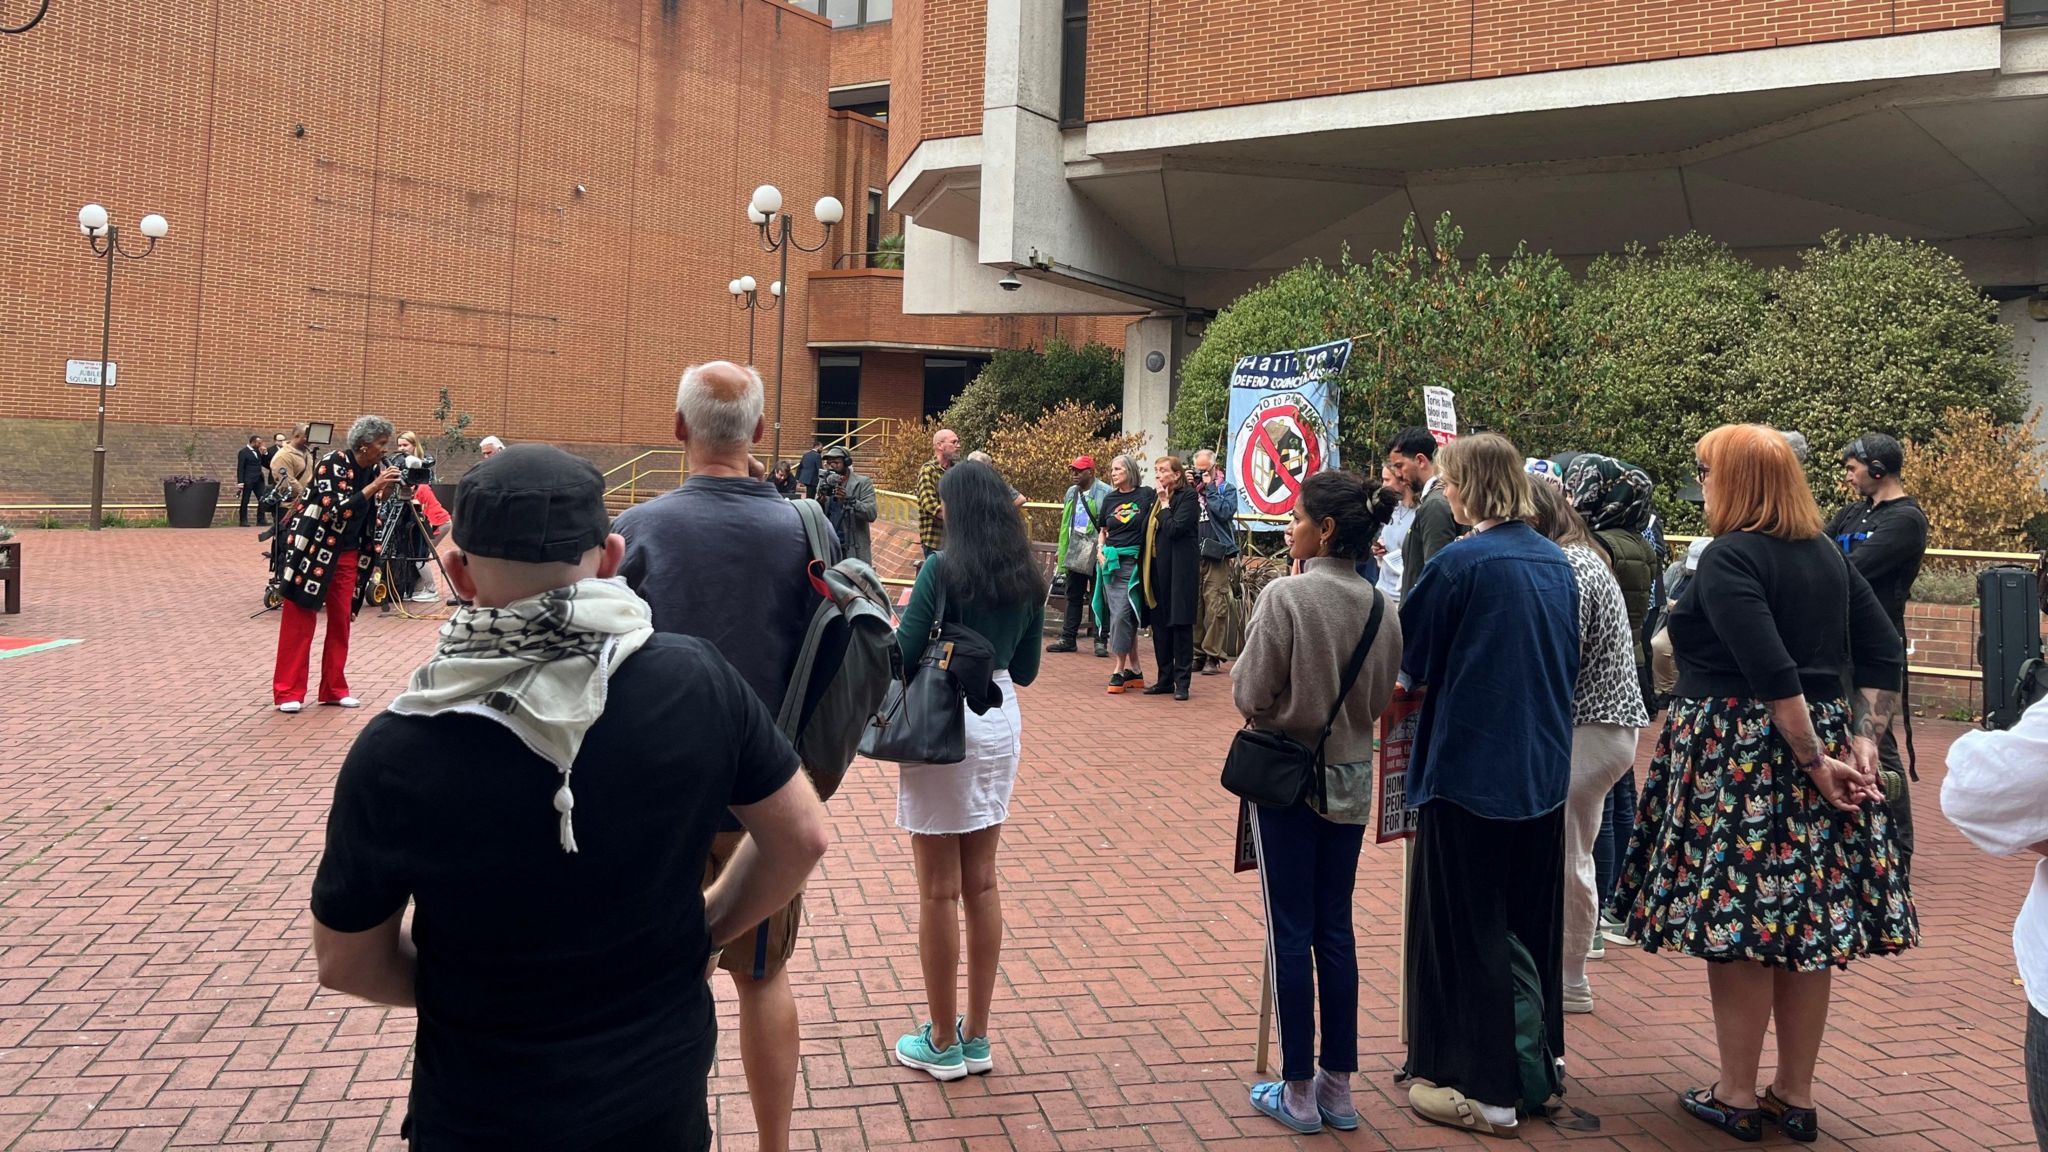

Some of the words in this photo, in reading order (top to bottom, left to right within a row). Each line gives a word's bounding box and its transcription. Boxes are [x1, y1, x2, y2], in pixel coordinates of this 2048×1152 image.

[1233, 374, 1270, 388] DEFEND
[1386, 775, 1407, 796] HOM
[1385, 793, 1407, 814] PEOP
[1384, 812, 1401, 833] FOR
